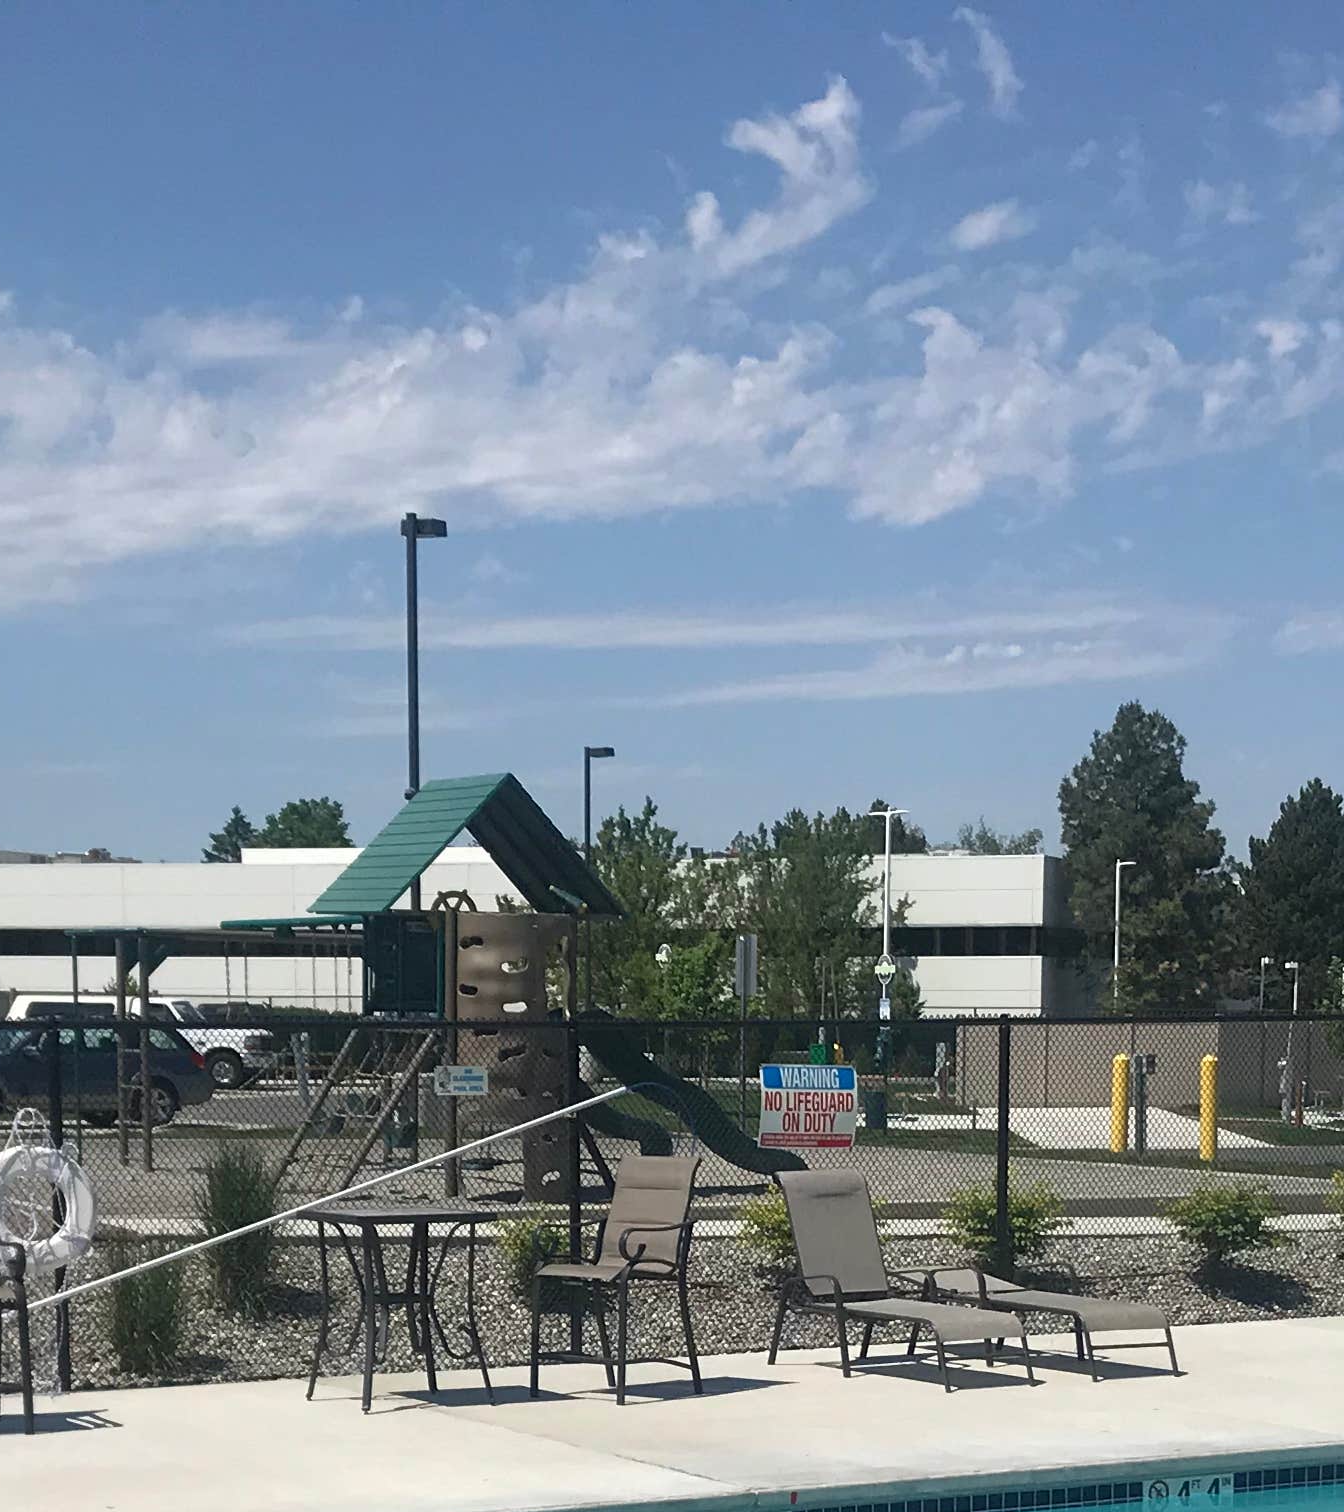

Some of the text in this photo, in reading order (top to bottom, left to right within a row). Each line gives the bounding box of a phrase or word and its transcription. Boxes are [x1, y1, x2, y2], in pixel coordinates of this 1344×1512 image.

[780, 1067, 840, 1088] WARNING
[764, 1091, 854, 1112] NO LIFEGUARD
[782, 1113, 837, 1132] ON DUTY
